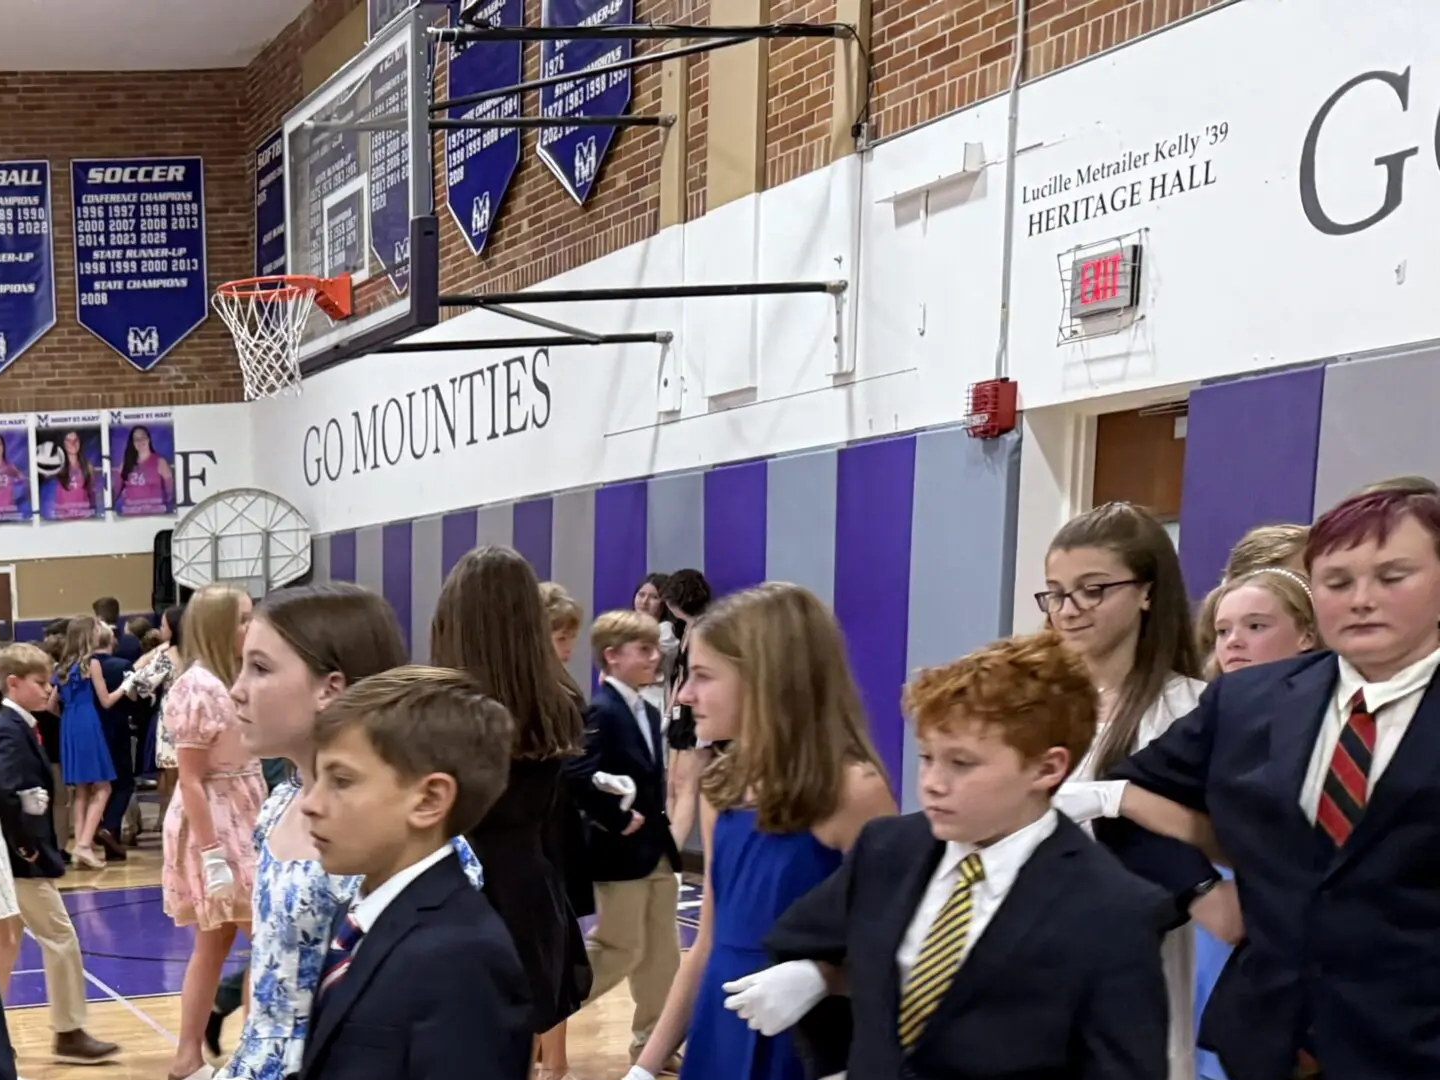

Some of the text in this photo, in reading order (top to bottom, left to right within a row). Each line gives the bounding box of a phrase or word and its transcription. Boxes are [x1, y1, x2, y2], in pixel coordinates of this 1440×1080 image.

[1022, 121, 1229, 204] Lucille Metrailer Kelly '39
[87, 165, 186, 184] SOCCER
[82, 191, 193, 204] CONFERENCE CHAMPIONS
[1027, 159, 1217, 237] HERITAGE HALL
[77, 203, 198, 219] 1996 1997 1998 1999
[77, 220, 105, 233] 2000
[108, 219, 136, 232] 2007
[171, 217, 199, 230] 2013
[78, 231, 167, 247] 2014 2023 2025
[92, 247, 187, 260] STATE RUNNER-UP
[79, 258, 199, 275] 1998 1999 2000 2013
[93, 278, 188, 291] STATE CHAMPIONS
[1081, 253, 1123, 305] EXIT
[303, 418, 344, 487] GO
[351, 346, 552, 475] MOUNTIES
